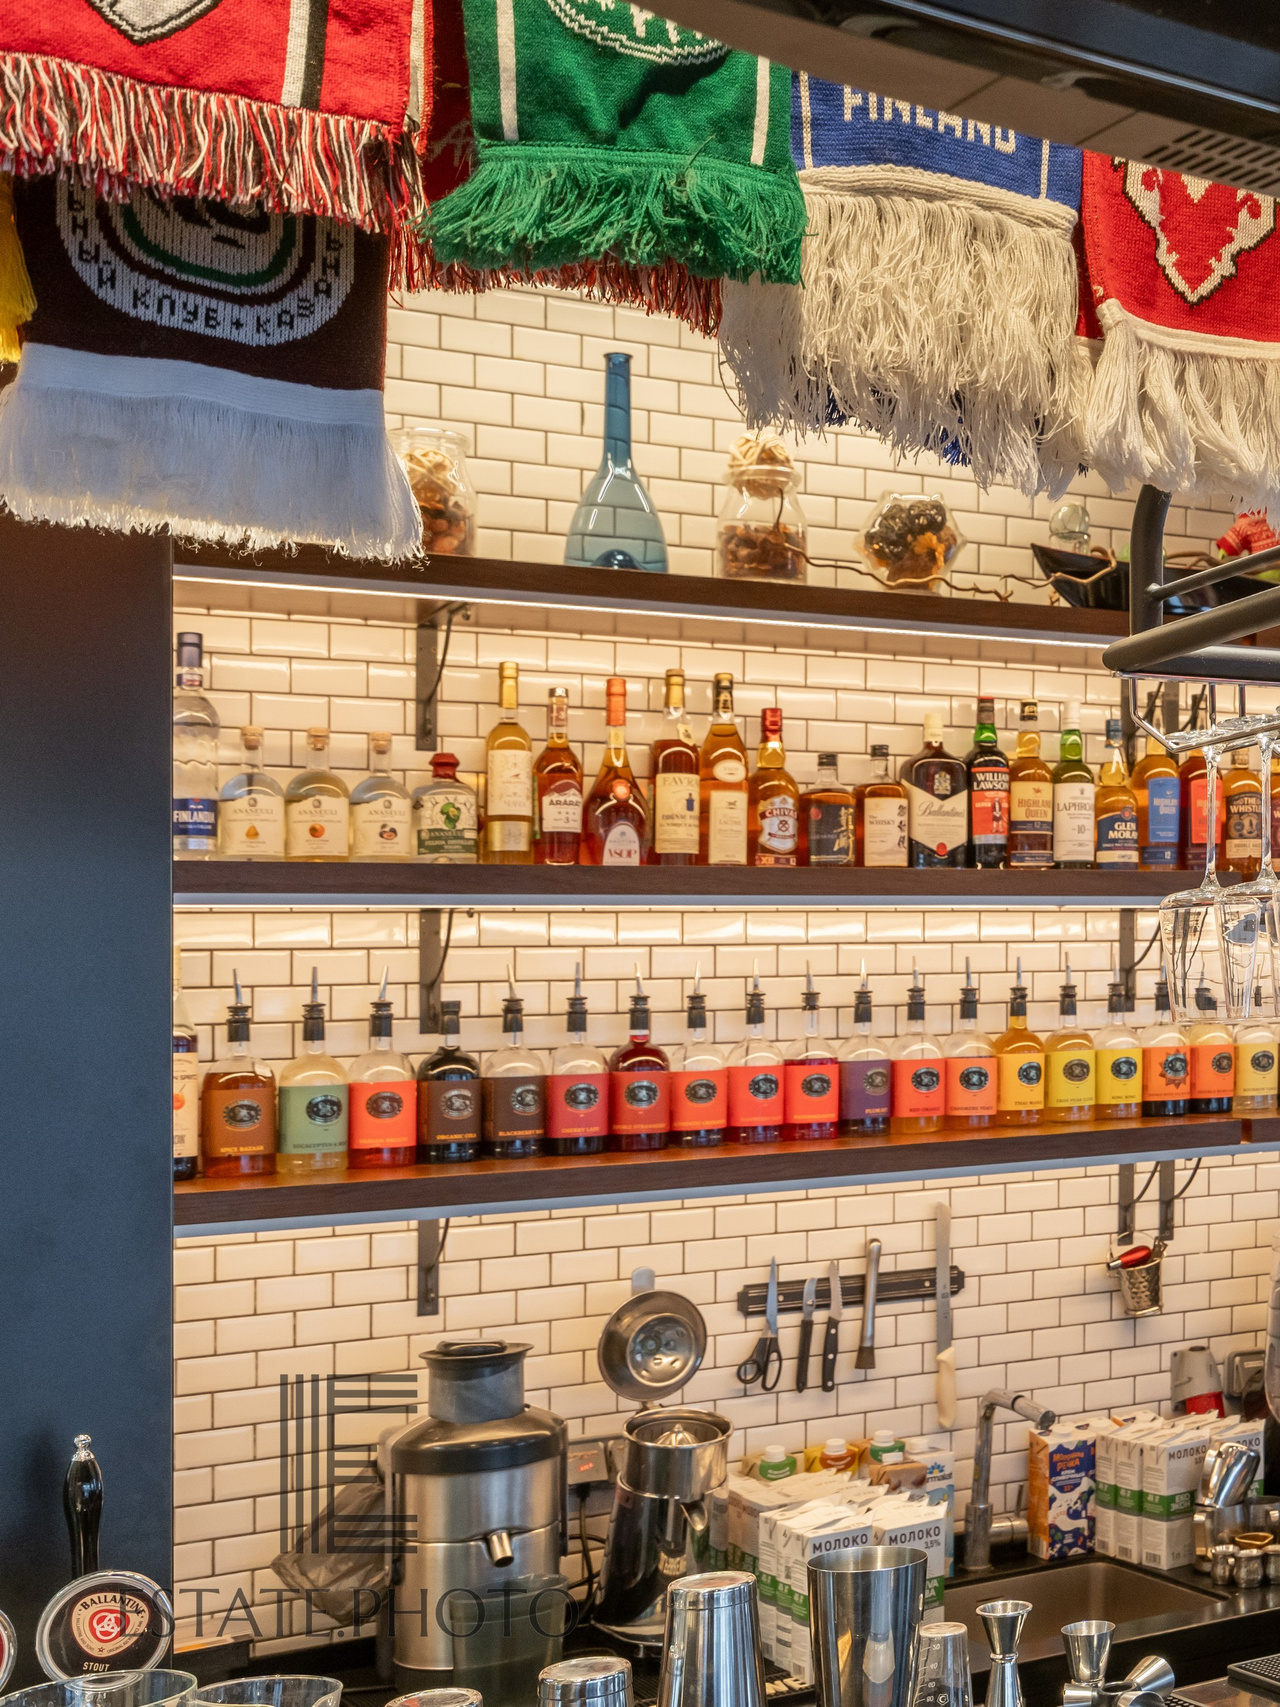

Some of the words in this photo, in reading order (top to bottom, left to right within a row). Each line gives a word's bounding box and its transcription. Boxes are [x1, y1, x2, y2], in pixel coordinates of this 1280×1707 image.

[1114, 821, 1137, 831] GLEN
[1167, 1444, 1207, 1462] МОЛОКО
[812, 1533, 869, 1554] МОЛОКО
[888, 1525, 942, 1547] МОЛОКО
[80, 1594, 147, 1617] BALLANTINE
[82, 1661, 110, 1672] STOUT
